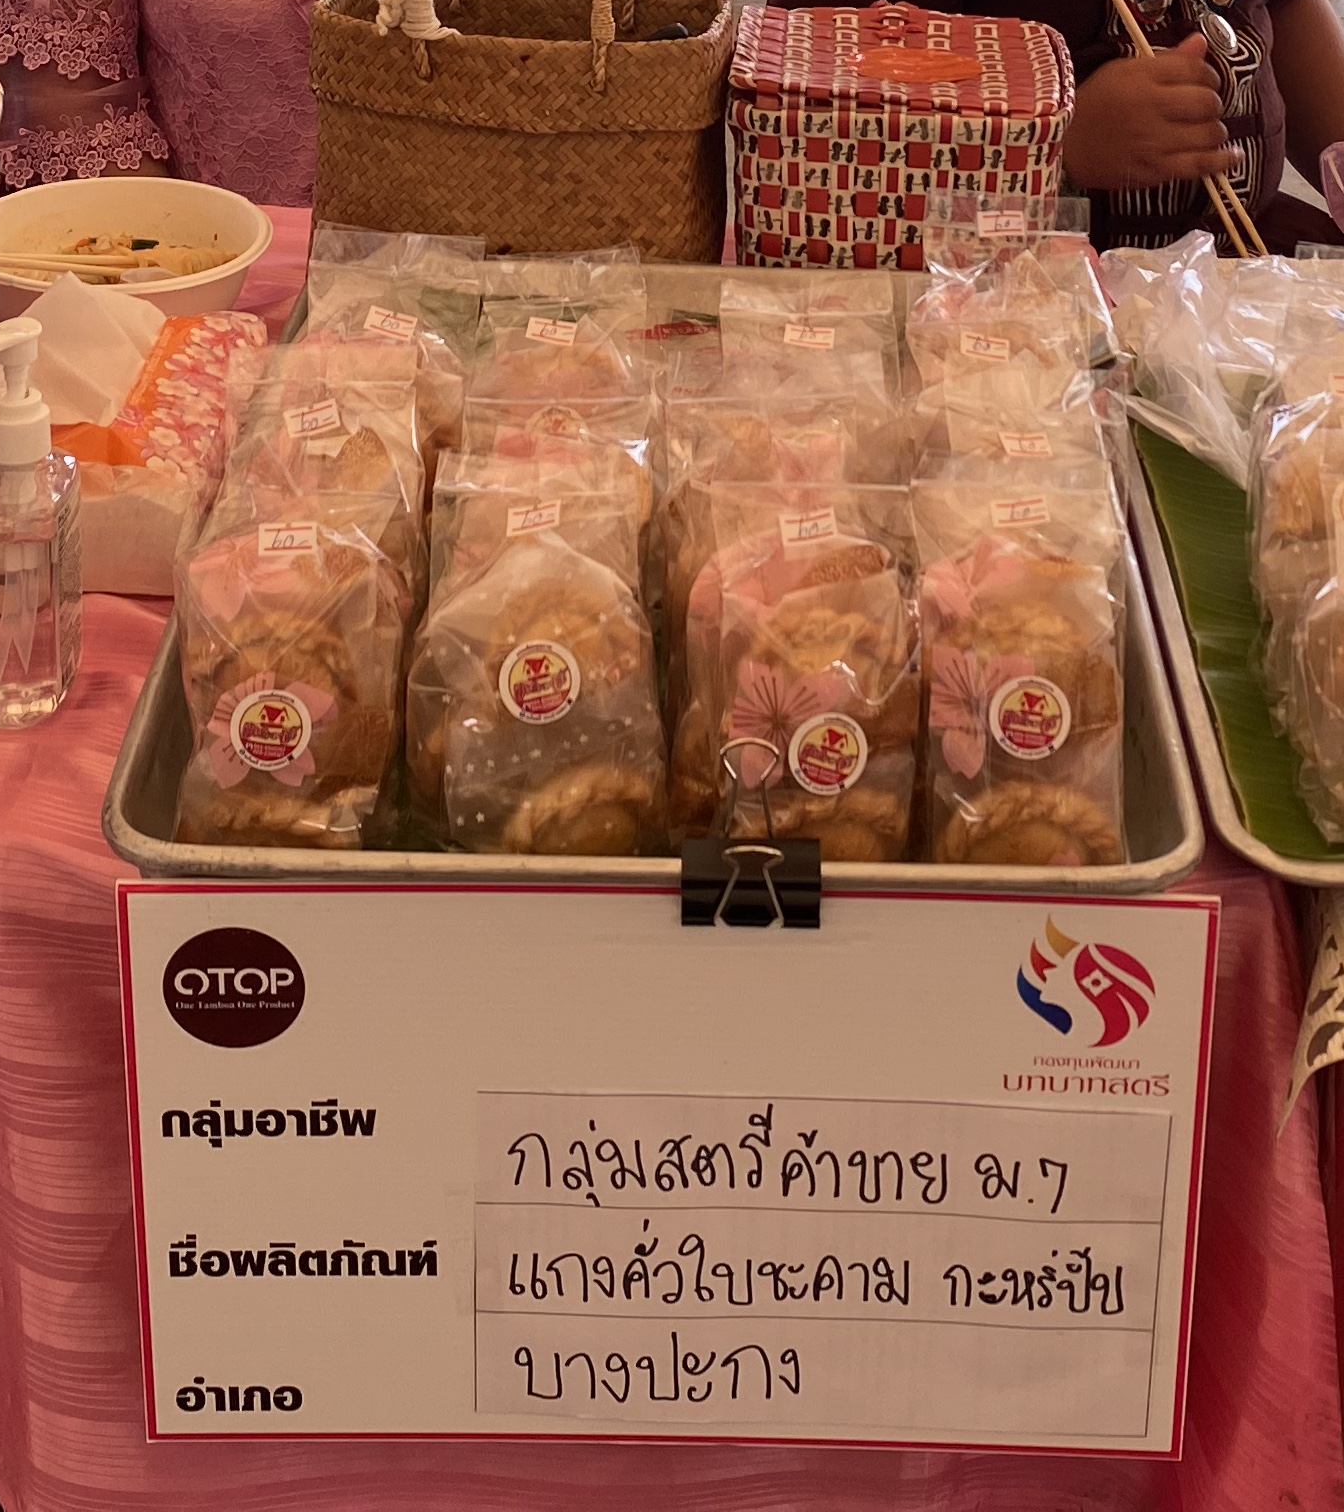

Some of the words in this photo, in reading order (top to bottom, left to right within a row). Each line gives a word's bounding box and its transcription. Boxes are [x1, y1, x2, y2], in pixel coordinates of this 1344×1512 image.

[173, 967, 295, 996] OTOP
[1033, 1055, 1141, 1071] กองทุนพัฒนา
[1003, 1073, 1171, 1097] บทบาทสตรี
[161, 1098, 377, 1149] กลุ่มอาชีพ
[168, 1233, 439, 1278] ชื่อผลิตภัณฑ์
[514, 1331, 801, 1403] บางปะกง
[175, 1376, 303, 1412] อำเภอ
